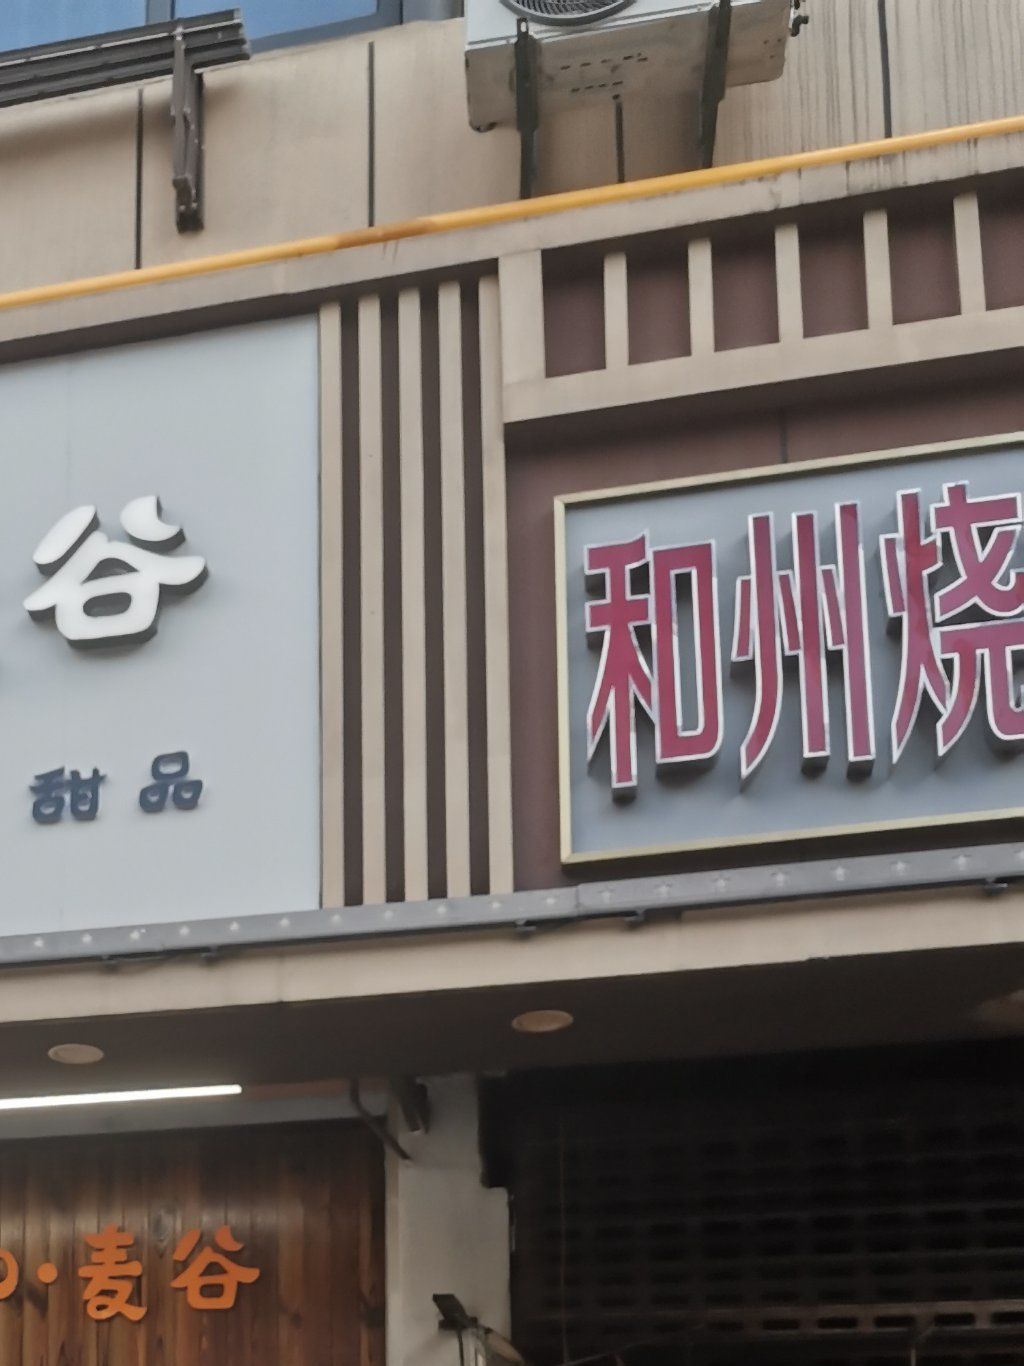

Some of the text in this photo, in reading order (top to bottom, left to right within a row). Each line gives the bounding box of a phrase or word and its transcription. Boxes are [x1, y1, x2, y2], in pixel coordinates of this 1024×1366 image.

[584, 480, 1024, 789] 和州烧
[29, 750, 205, 825] 甜品
